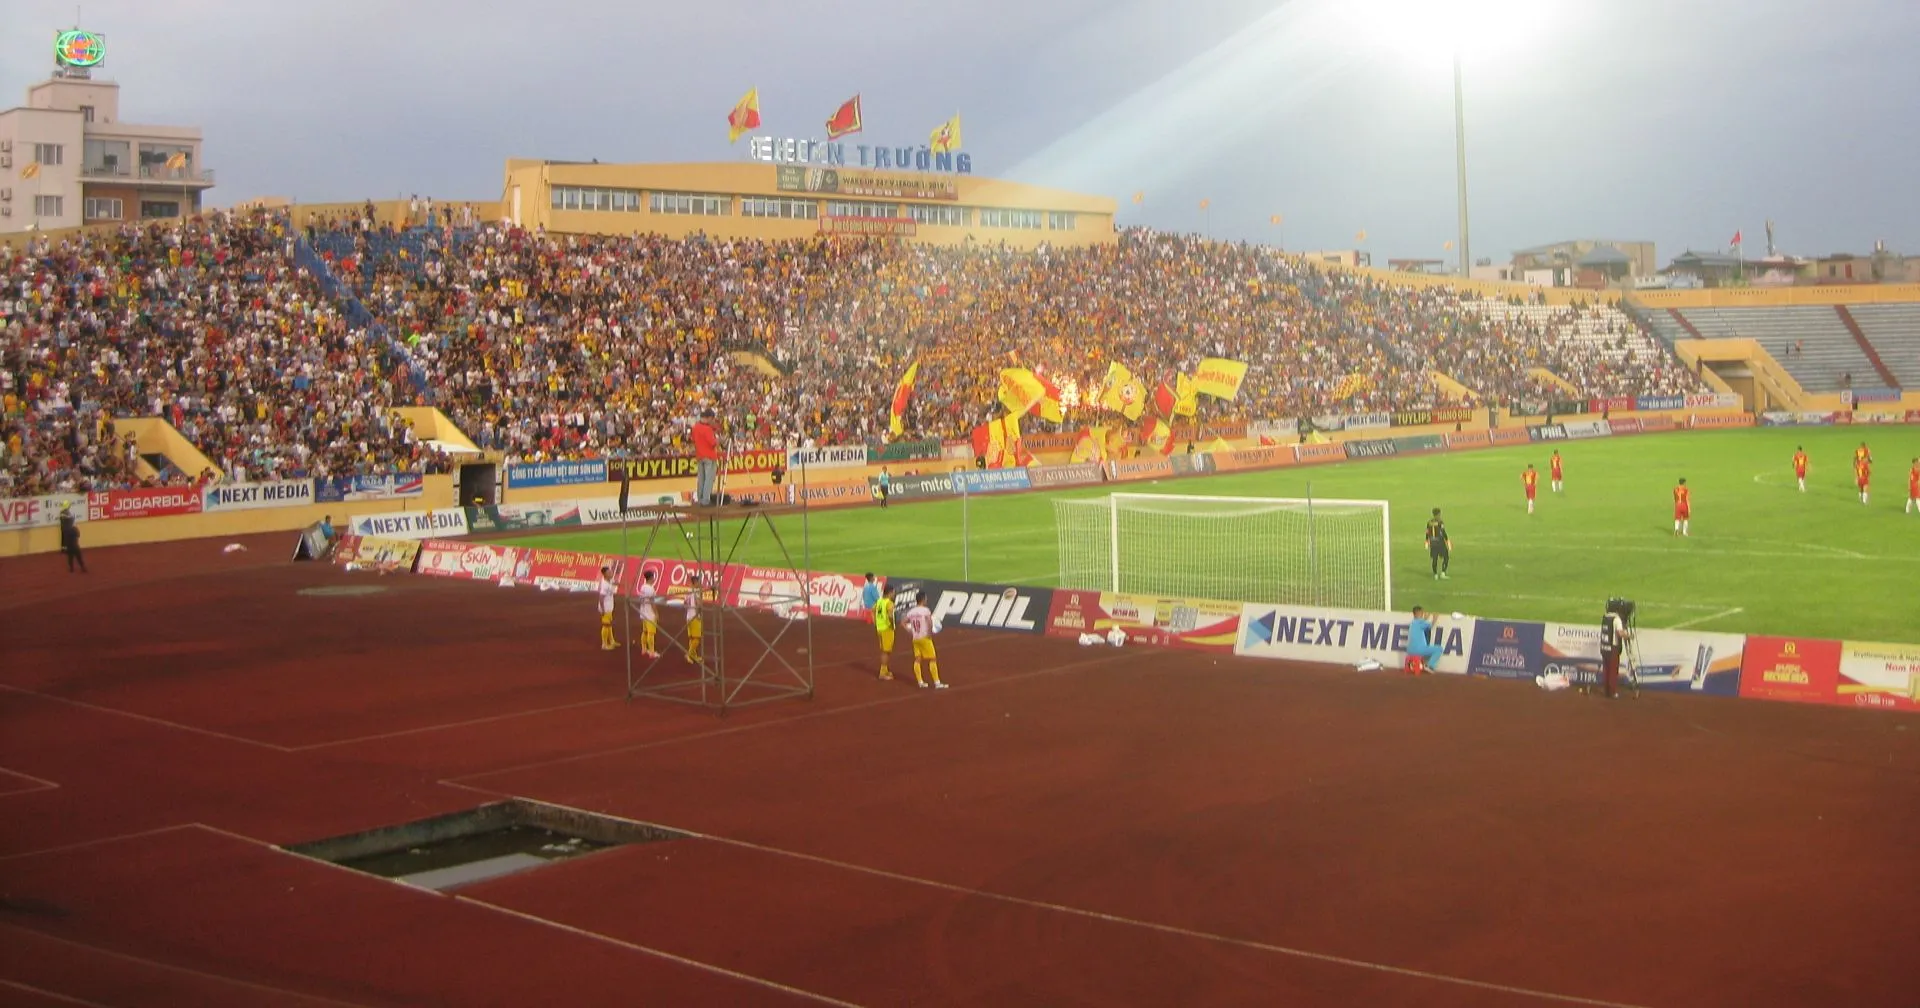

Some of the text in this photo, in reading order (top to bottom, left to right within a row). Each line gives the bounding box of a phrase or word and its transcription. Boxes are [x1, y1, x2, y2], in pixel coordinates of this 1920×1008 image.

[857, 144, 971, 173] TRƯỜNG
[1397, 411, 1432, 424] TUYLIPS
[757, 450, 785, 470] ONE
[800, 448, 865, 464] NEXT MEDIA
[627, 456, 698, 478] TUYLIPS
[1046, 467, 1095, 481] AGRIBANK
[222, 486, 259, 504] NEXT
[263, 483, 310, 500] MEDIA
[832, 487, 846, 498] UP
[850, 486, 866, 496] 247
[921, 477, 952, 494] mitre
[89, 492, 109, 507] JG
[113, 493, 201, 511] JOGARBOLA
[0, 500, 41, 524] VPF
[90, 507, 110, 521] BL
[588, 508, 657, 522] Vietcomban
[374, 517, 412, 534] NEXT
[416, 512, 464, 531] MEDIA
[466, 550, 492, 566] SKIN
[576, 552, 597, 567] Thanh
[810, 578, 846, 599] SKIN
[822, 597, 847, 614] BIBI
[1276, 615, 1354, 647] NEXT
